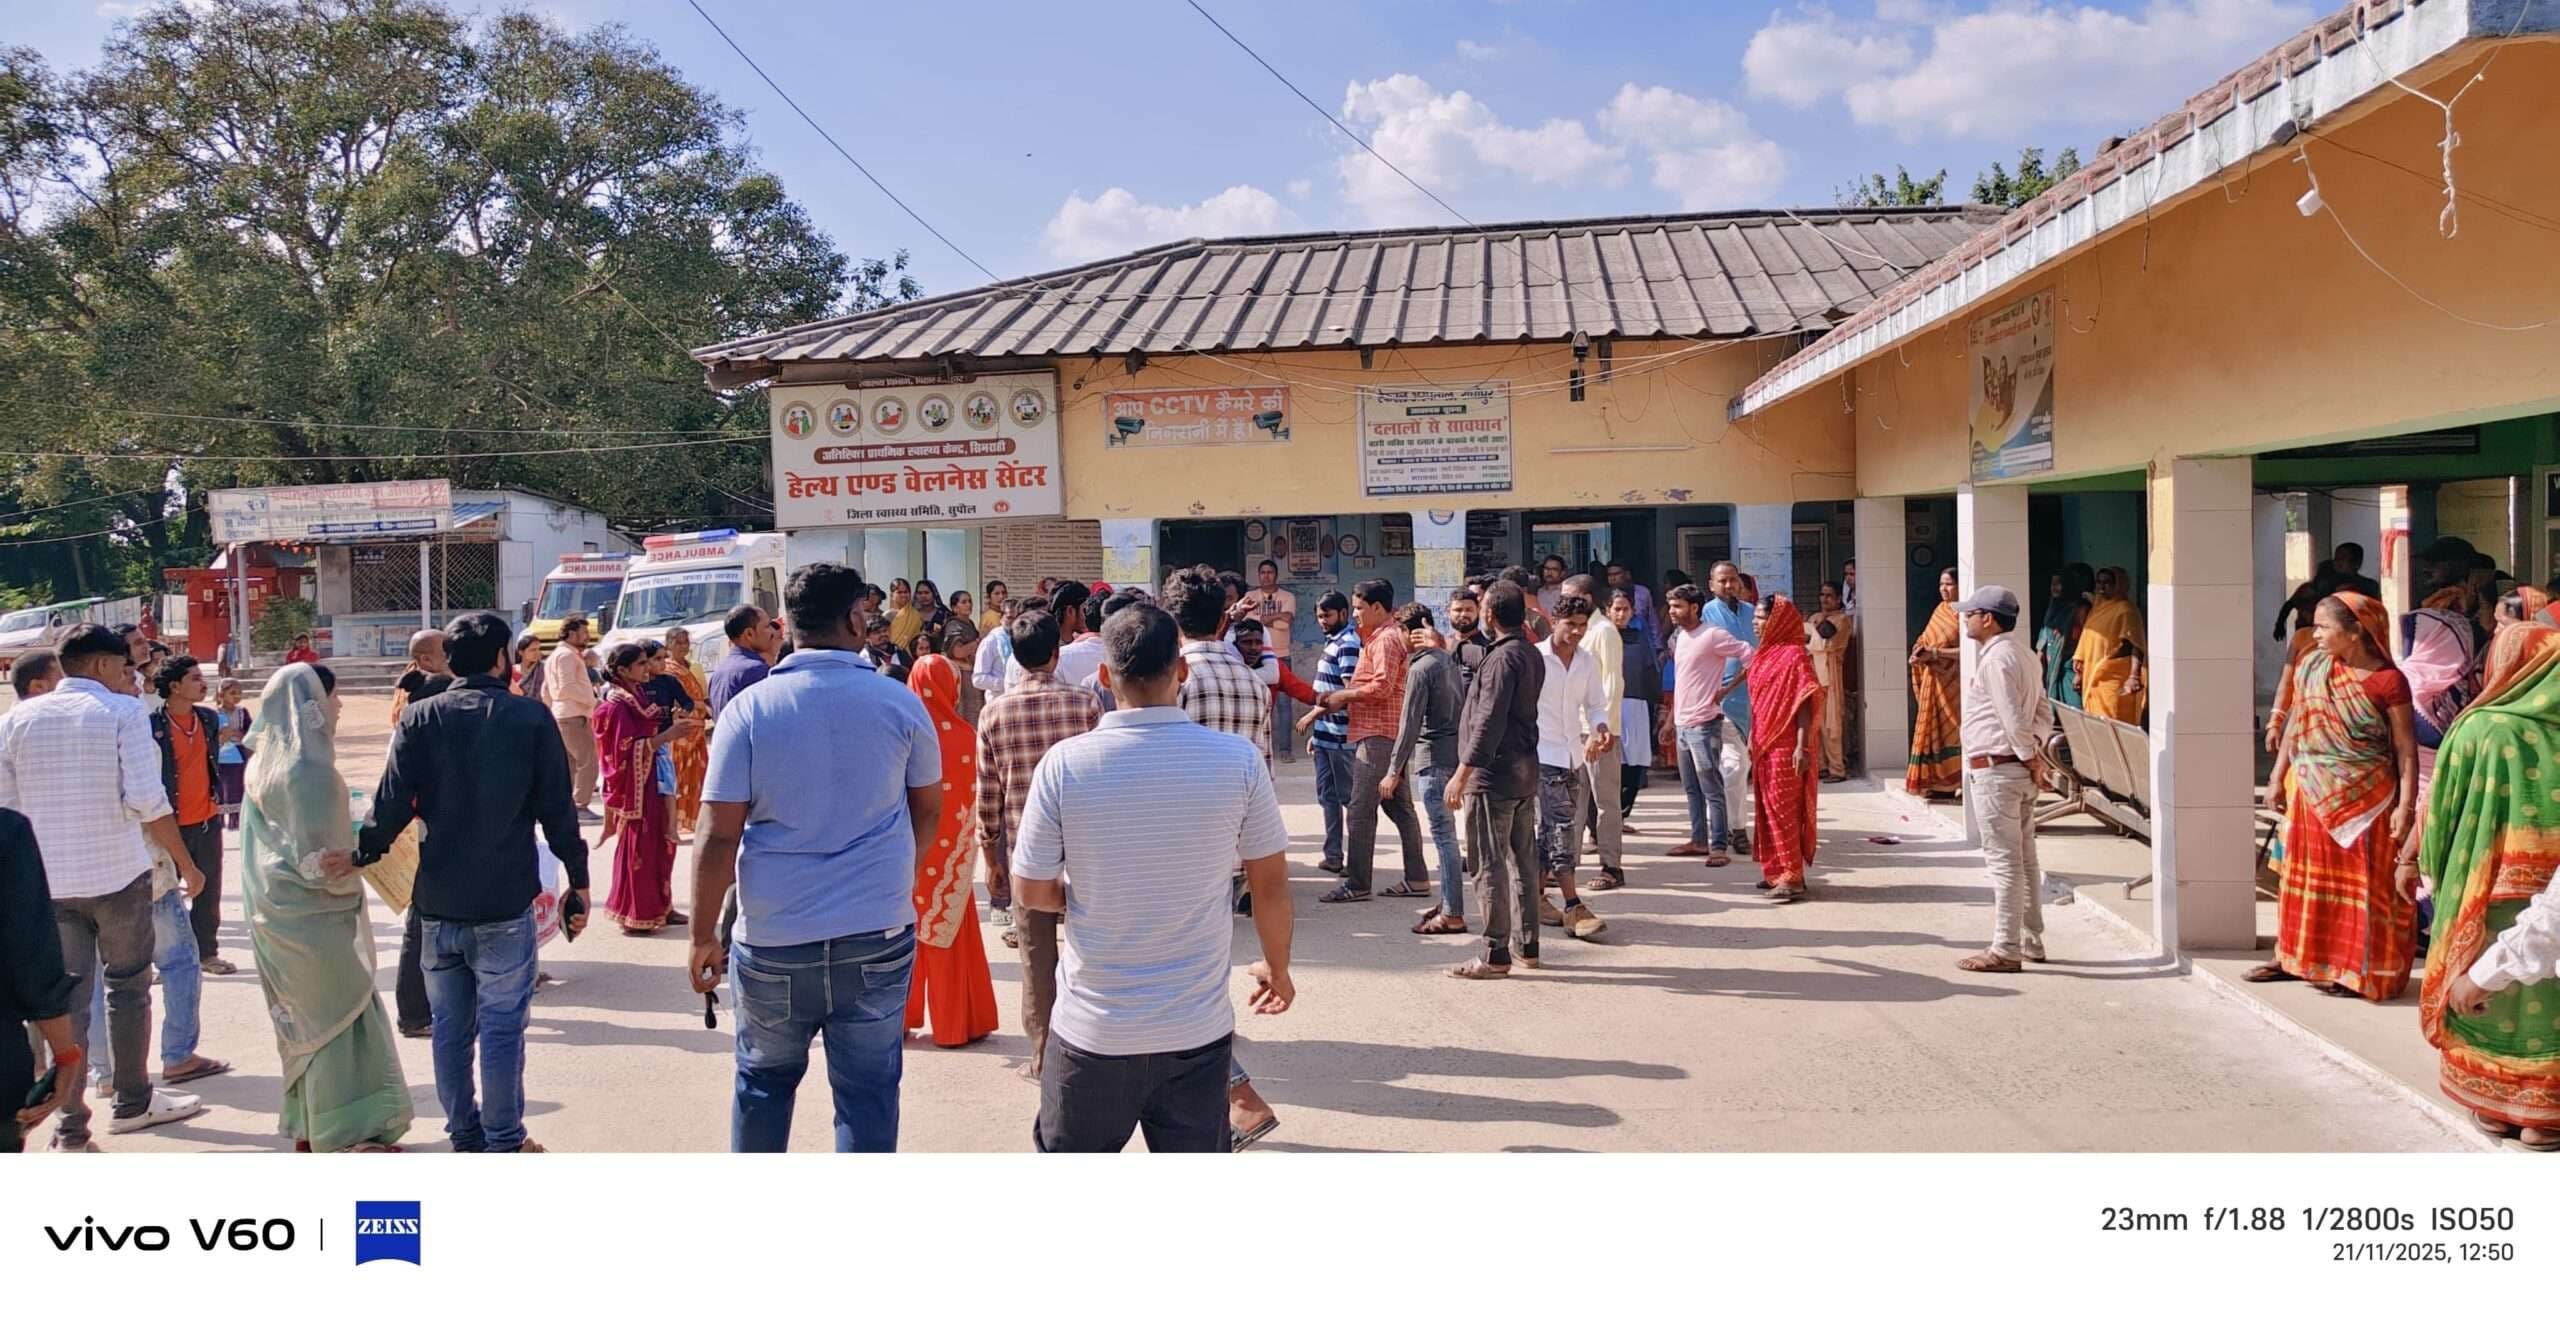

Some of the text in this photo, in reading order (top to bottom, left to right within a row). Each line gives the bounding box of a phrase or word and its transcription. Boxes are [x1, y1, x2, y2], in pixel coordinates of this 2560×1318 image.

[1113, 389, 1284, 416] आप CCTV कैमरे की
[1427, 417, 1440, 433] से
[784, 460, 1047, 498] हेल्थ एण्ड वेलनेस सेंटर
[846, 508, 873, 520] जिला
[876, 507, 907, 518] स्वास्थ्य
